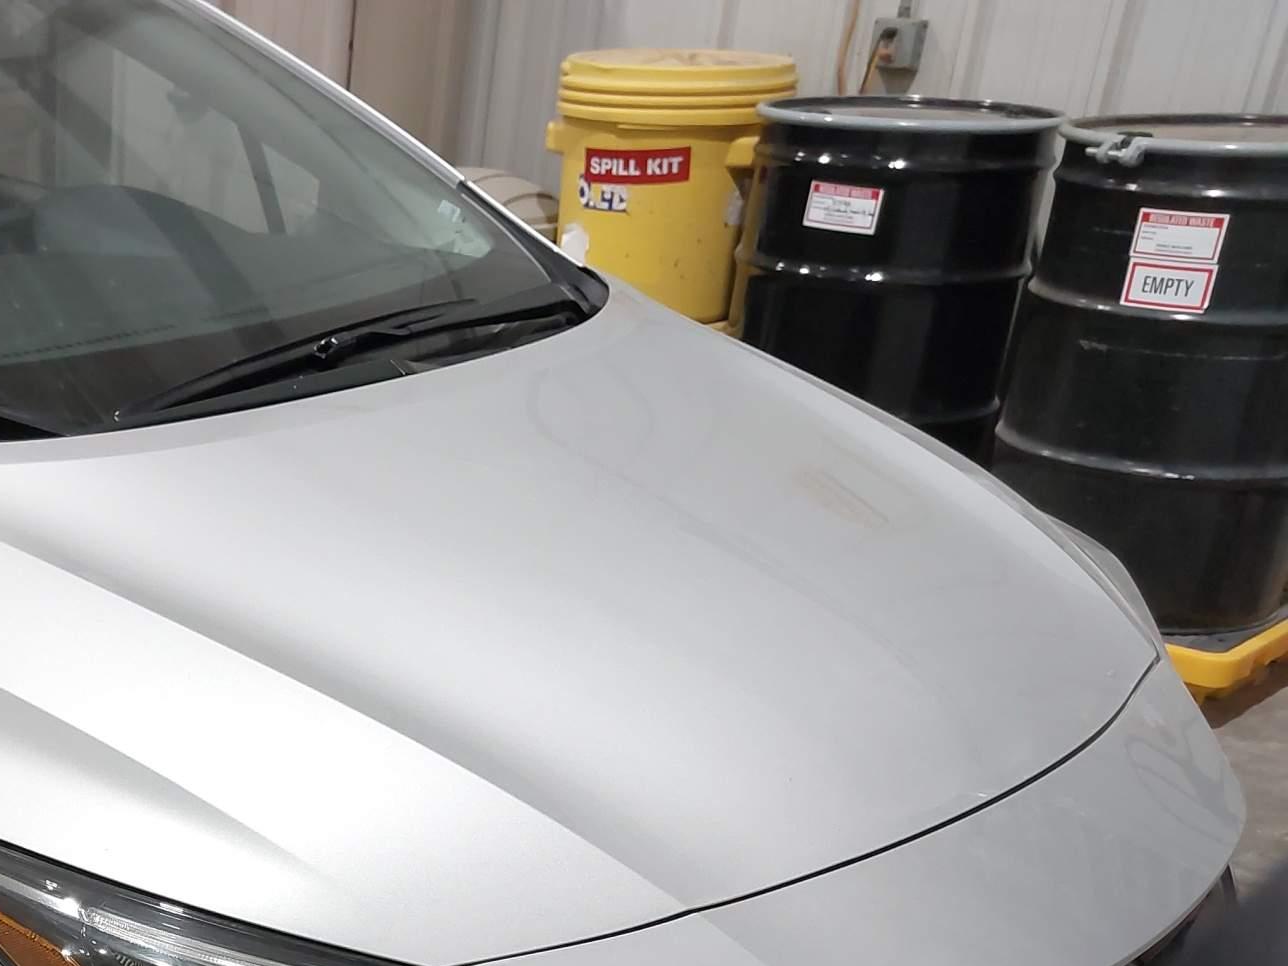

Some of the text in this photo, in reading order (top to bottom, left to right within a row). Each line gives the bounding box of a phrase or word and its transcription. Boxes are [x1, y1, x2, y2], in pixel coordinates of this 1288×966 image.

[590, 156, 683, 176] SPILL KIT
[1141, 275, 1195, 298] EMPTY
